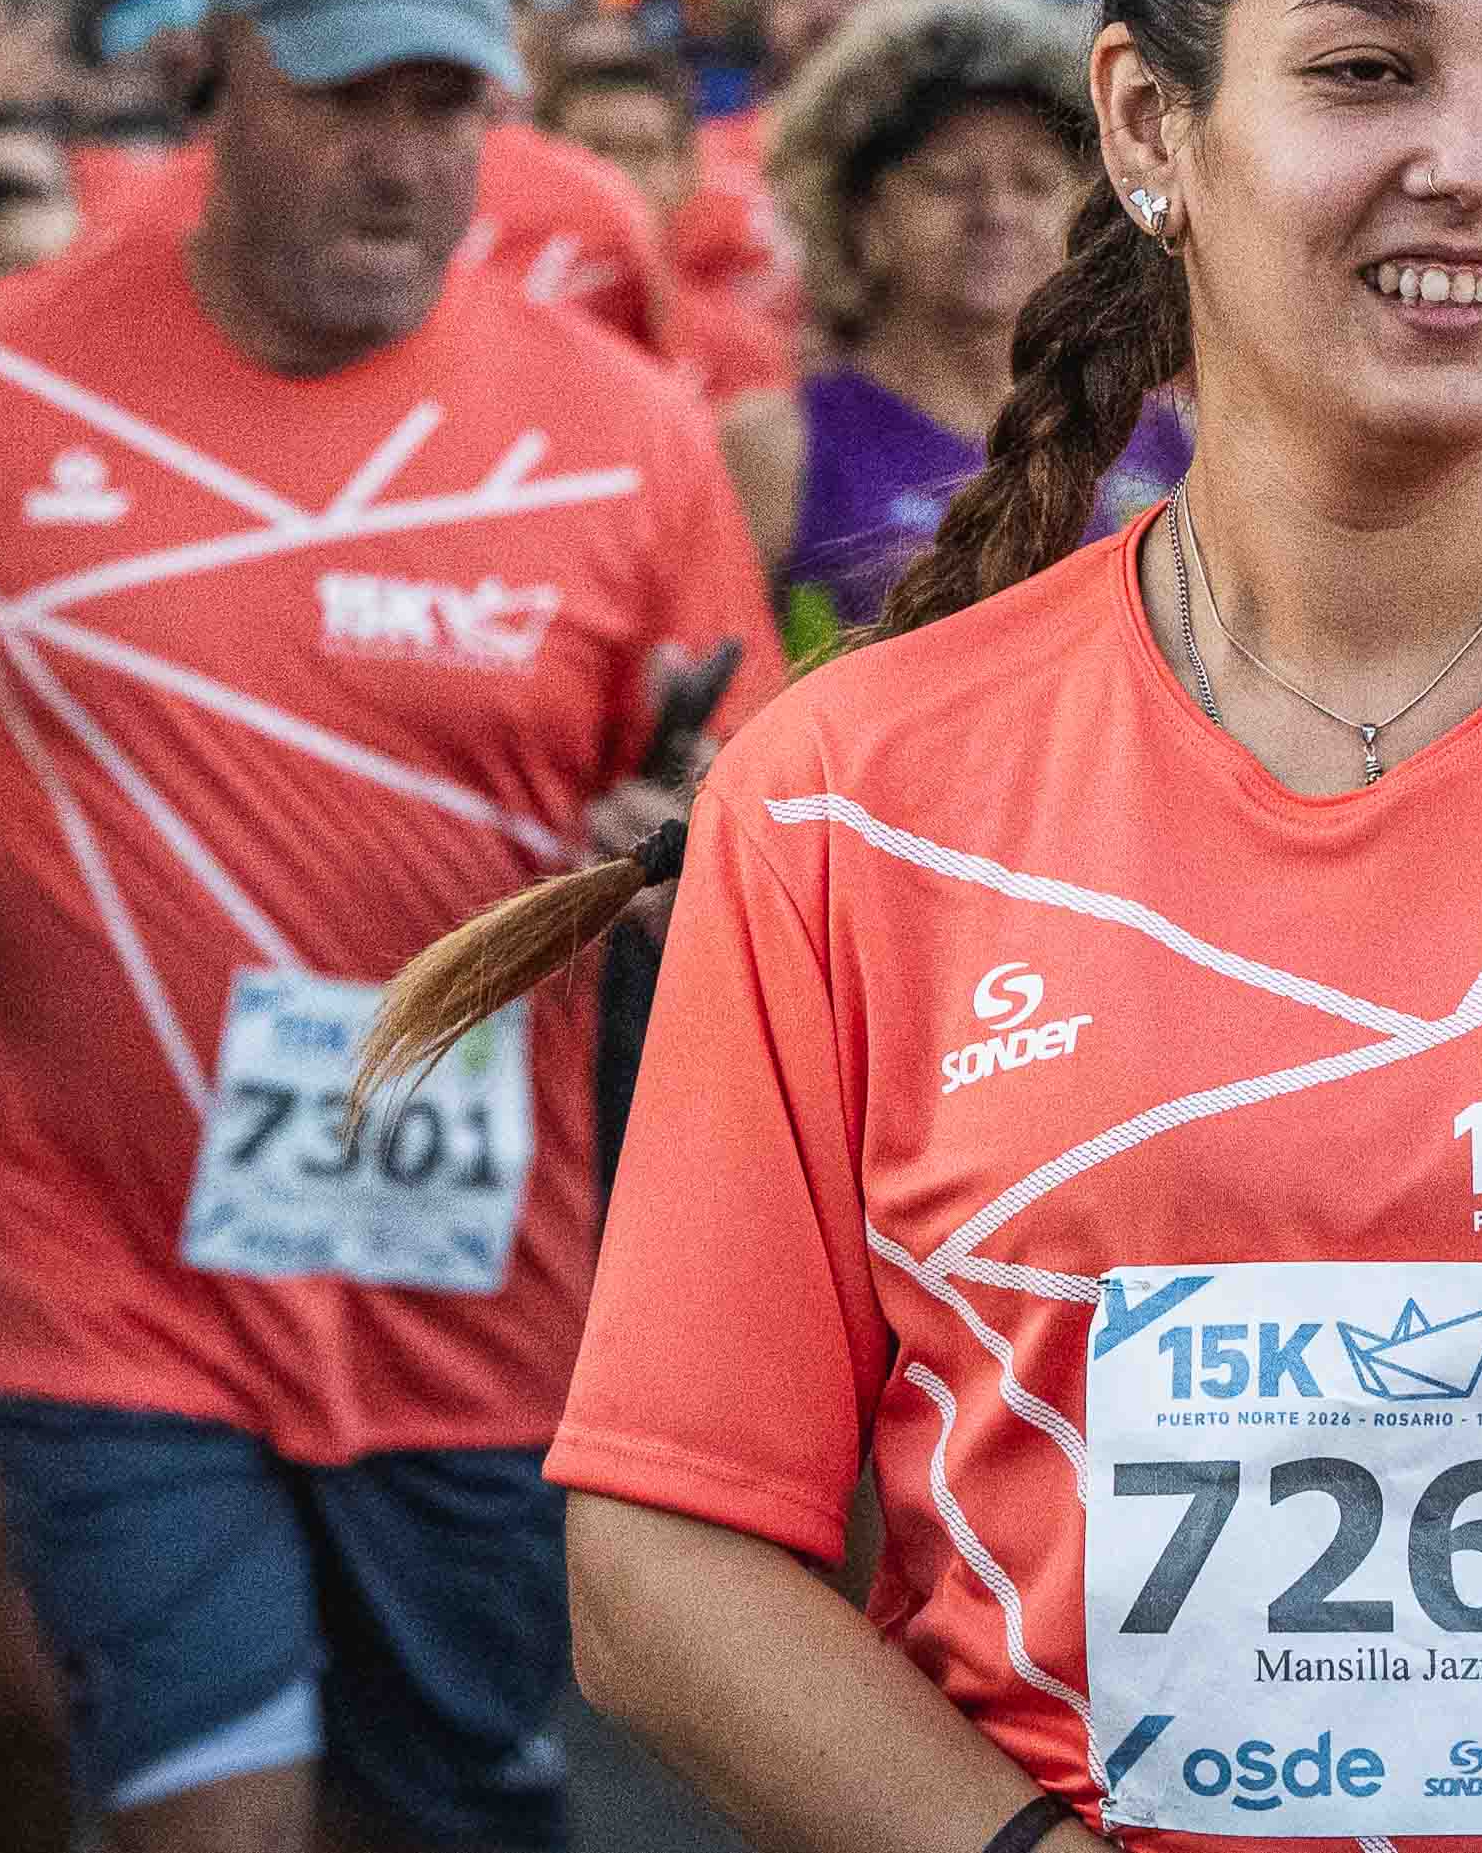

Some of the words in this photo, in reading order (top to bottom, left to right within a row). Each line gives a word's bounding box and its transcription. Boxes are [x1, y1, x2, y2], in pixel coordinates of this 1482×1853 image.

[231, 1079, 499, 1191] 7301
[1158, 1322, 1324, 1400] 15K
[1157, 1411, 1230, 1426] PUERTO
[1238, 1410, 1300, 1426] NORTE
[1307, 1411, 1351, 1426] 2026
[1374, 1412, 1454, 1427] ROSARIO
[1255, 1647, 1411, 1682] Mansilla
[1183, 1730, 1386, 1798] osde
